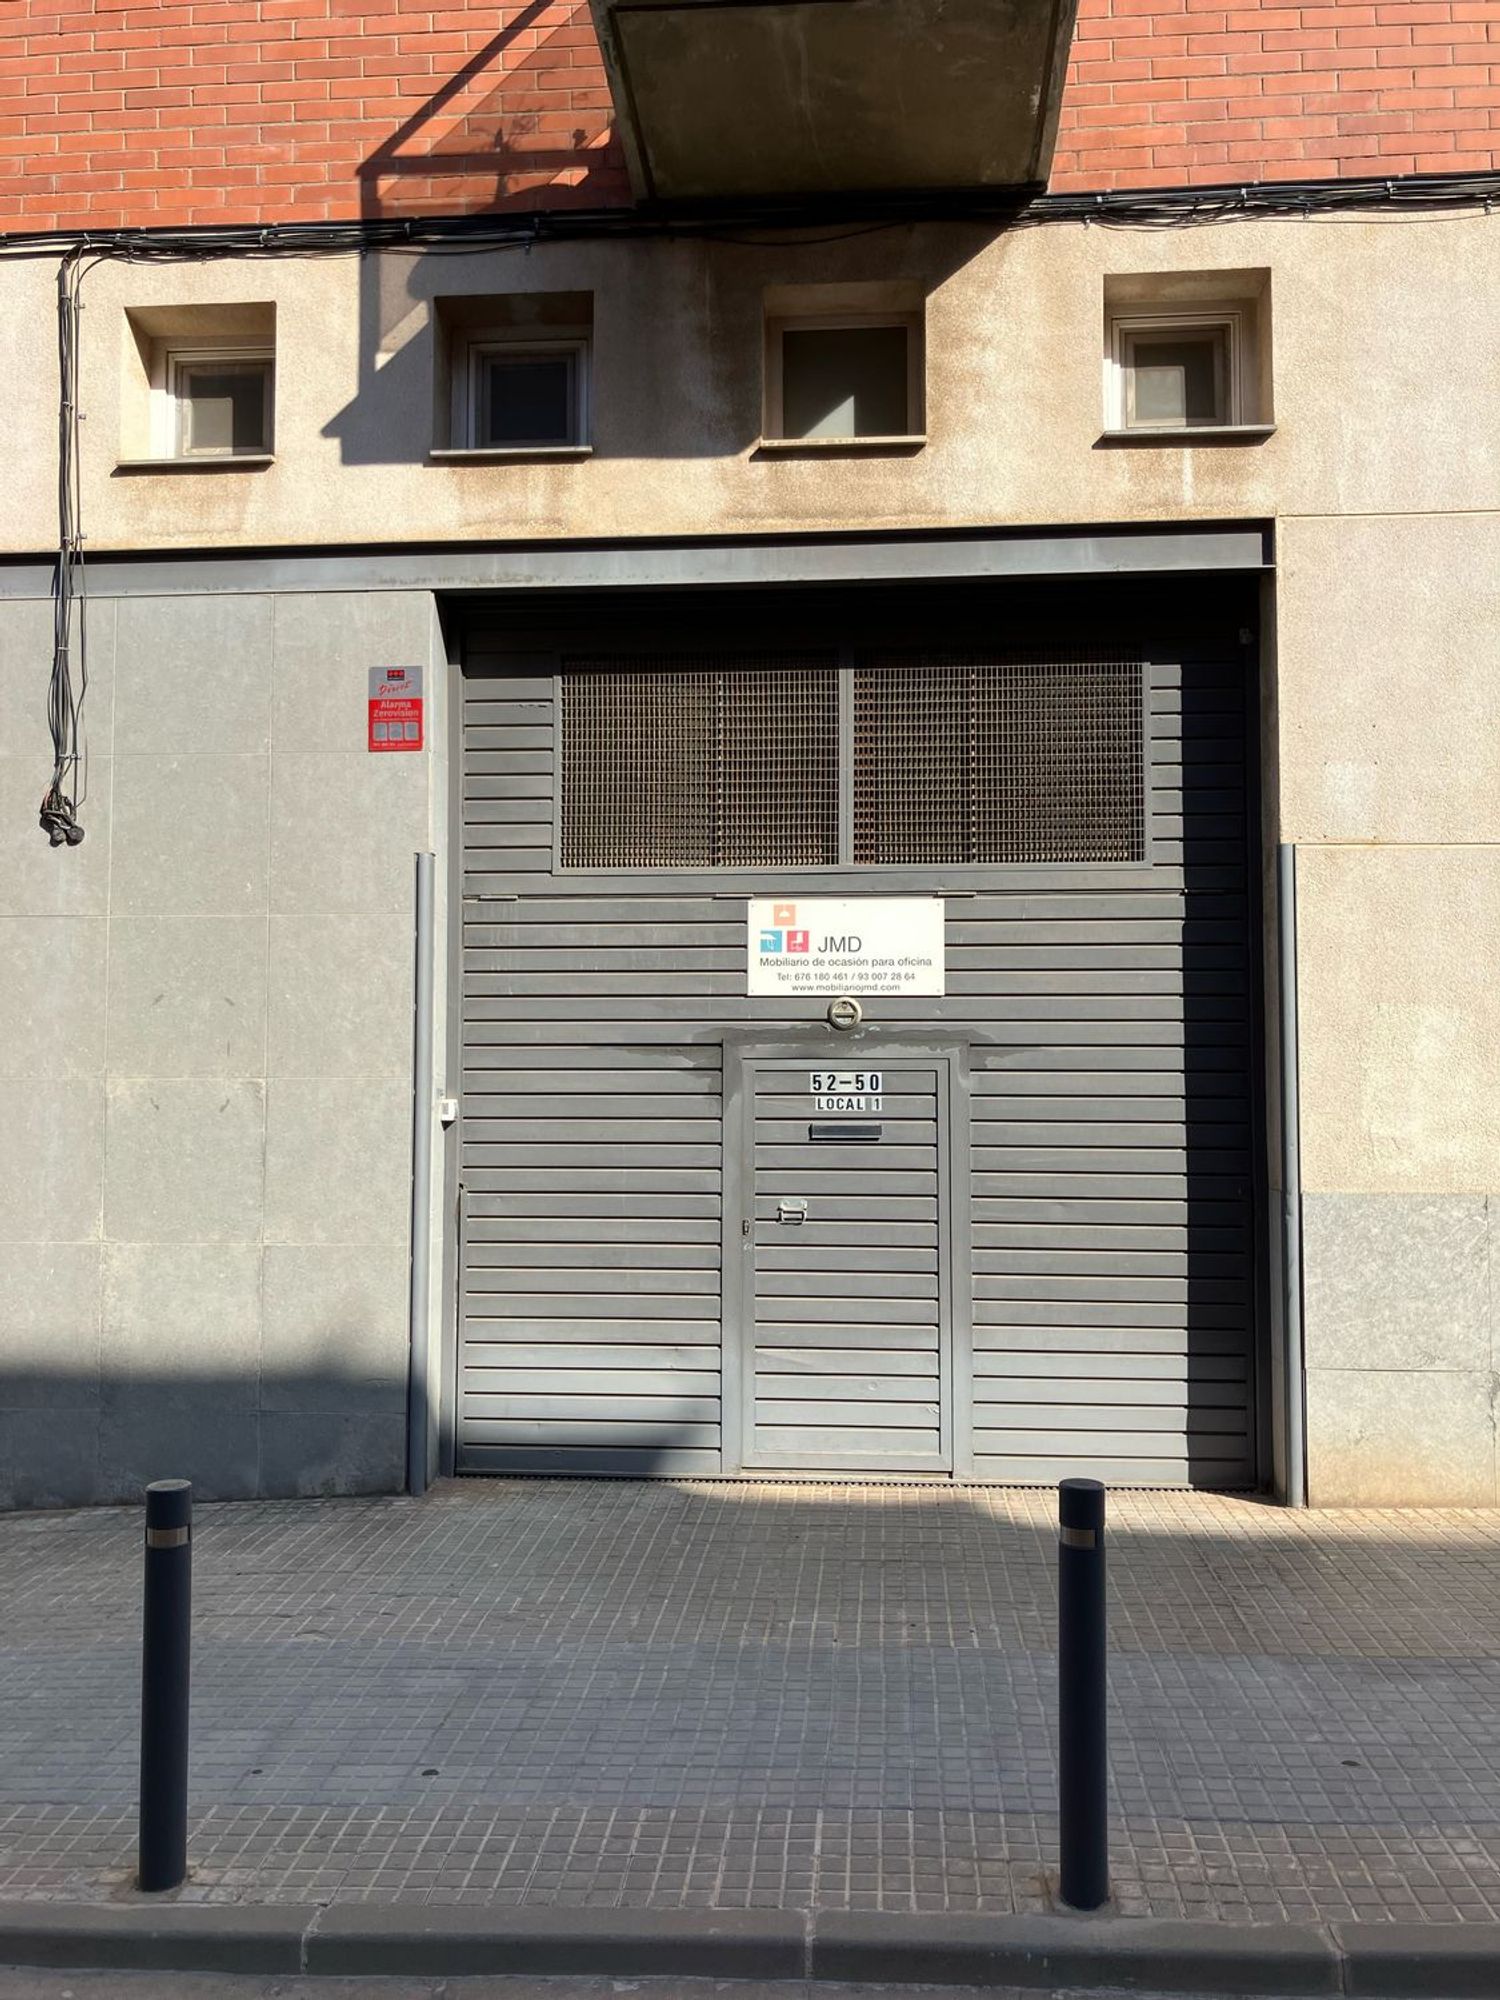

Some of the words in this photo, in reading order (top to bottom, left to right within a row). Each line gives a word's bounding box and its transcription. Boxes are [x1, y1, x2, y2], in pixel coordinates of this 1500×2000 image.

[381, 701, 412, 709] Alarma
[373, 709, 419, 718] Zerovision
[818, 936, 862, 953] JMD
[760, 957, 809, 967] Mobiliario
[812, 957, 826, 967] de
[828, 957, 869, 967] ocasión
[871, 959, 895, 968] para
[897, 957, 932, 967] oficina
[777, 972, 792, 981] Tel:
[794, 972, 811, 981] 676
[814, 972, 830, 981] 180
[832, 972, 848, 981] 461
[857, 972, 869, 981] 93
[871, 972, 888, 981] 007
[891, 972, 902, 981] 28
[904, 972, 916, 981] 64
[792, 983, 901, 993] www.mobiliariojmd.com
[812, 1074, 879, 1091] 52-50
[817, 1098, 864, 1110] LOCAL
[874, 1098, 880, 1110] 1
